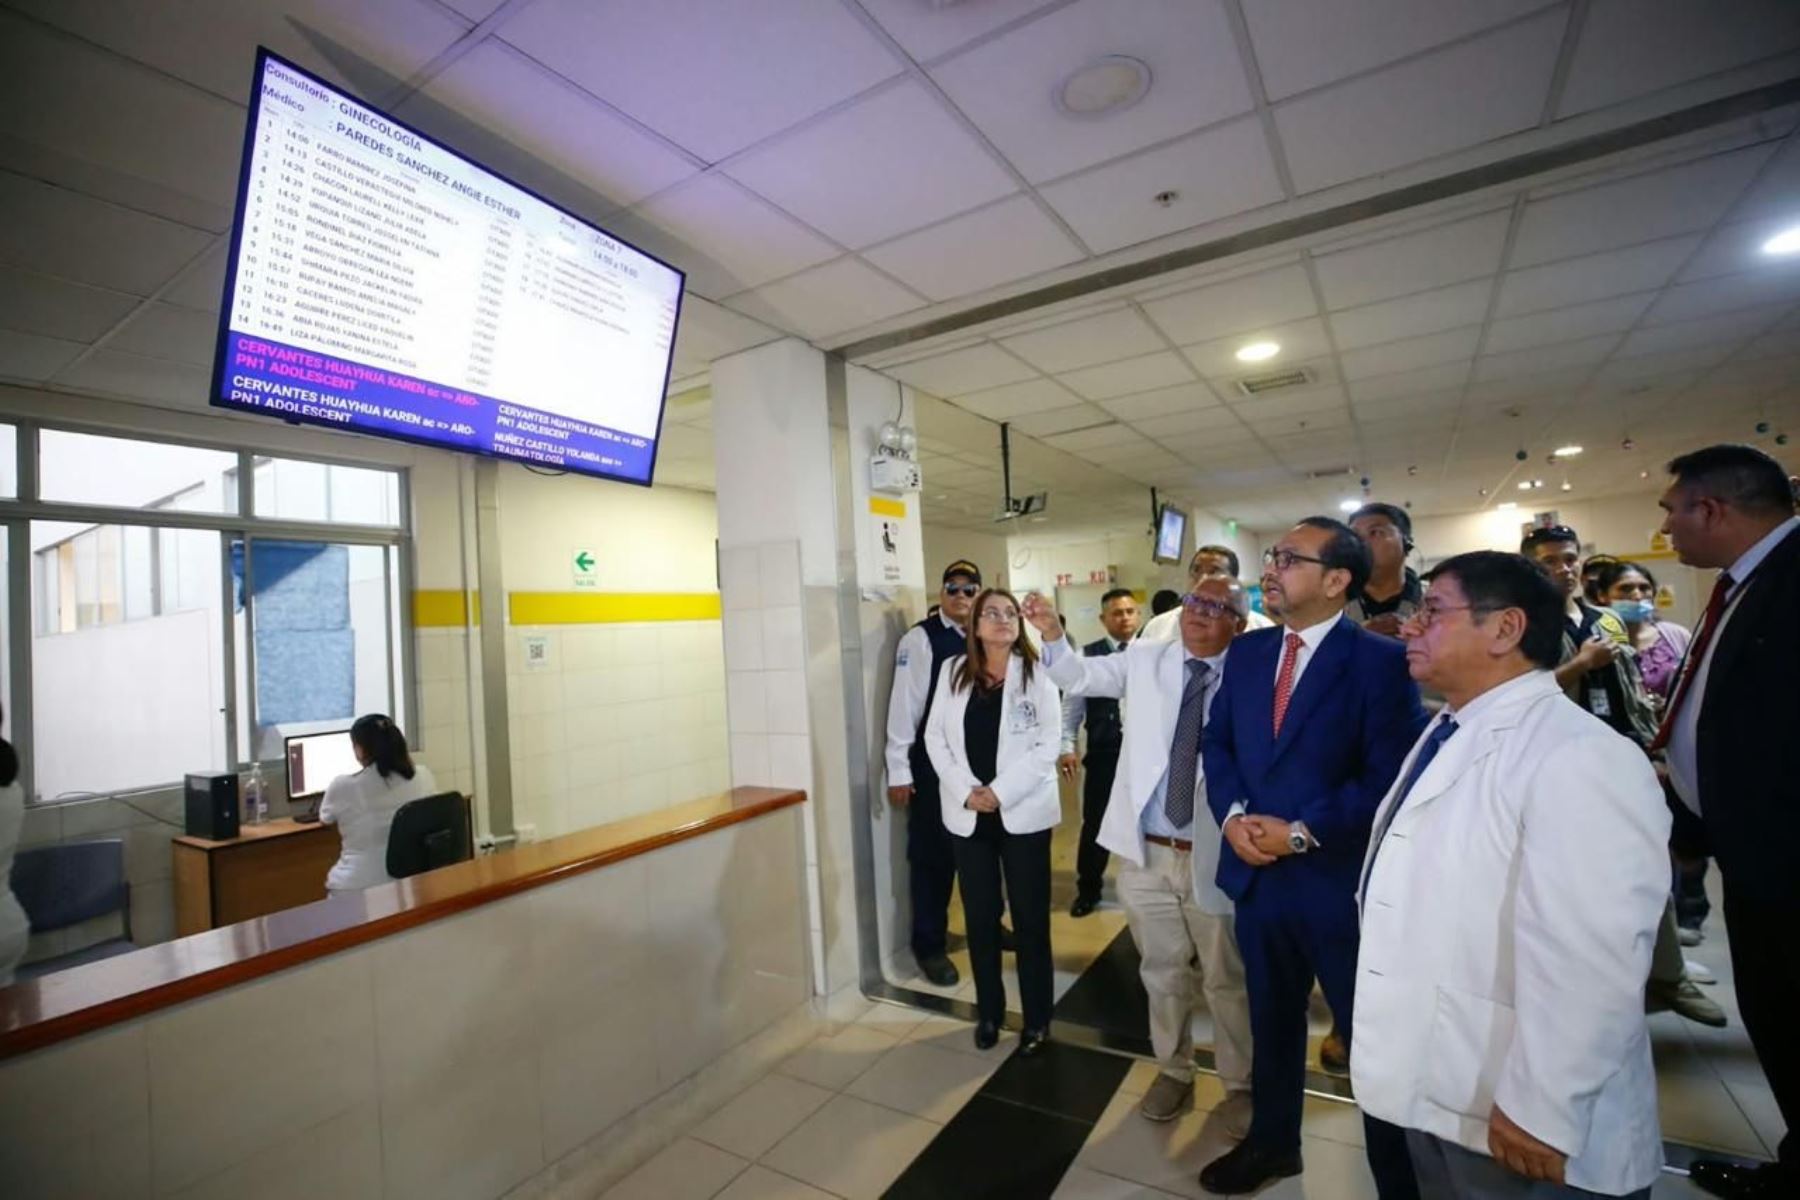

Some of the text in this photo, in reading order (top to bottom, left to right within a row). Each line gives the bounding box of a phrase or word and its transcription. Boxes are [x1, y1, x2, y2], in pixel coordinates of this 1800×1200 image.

[265, 64, 328, 104] Consultorio
[339, 102, 421, 152] GINECOLOGÍA
[263, 85, 304, 113] Médico
[336, 122, 393, 159] PAREDES
[395, 151, 448, 186] SANCHEZ
[451, 179, 482, 202] ANGIE
[484, 195, 520, 221] ESTHER
[305, 229, 326, 243] VEGA
[246, 254, 257, 264] 10
[244, 269, 255, 279] 11
[242, 284, 253, 294] 12
[240, 299, 251, 309] 13
[238, 314, 249, 324] 14
[236, 354, 357, 391] PN1 ADOLESCENT
[237, 338, 322, 368] CERVANTES
[325, 360, 385, 384] HUAYHUA
[387, 376, 425, 394] KAREN
[231, 390, 352, 423] PN1 ADOLESCENT
[232, 375, 317, 402] CERVANTES
[320, 394, 380, 415] HUAYHUA
[383, 408, 421, 424] KAREN
[450, 423, 475, 436] ARO-
[497, 416, 568, 440] PN1 ADOLESCENT
[498, 404, 548, 424] CERVANTES
[550, 417, 586, 433] HUAYHUA
[588, 427, 612, 440] KAREN
[493, 443, 564, 464] TRAUMATOLOGÍA
[494, 431, 524, 445] NUÑEZ
[525, 438, 564, 454] CASTILLO
[565, 447, 599, 462] YOLANDA
